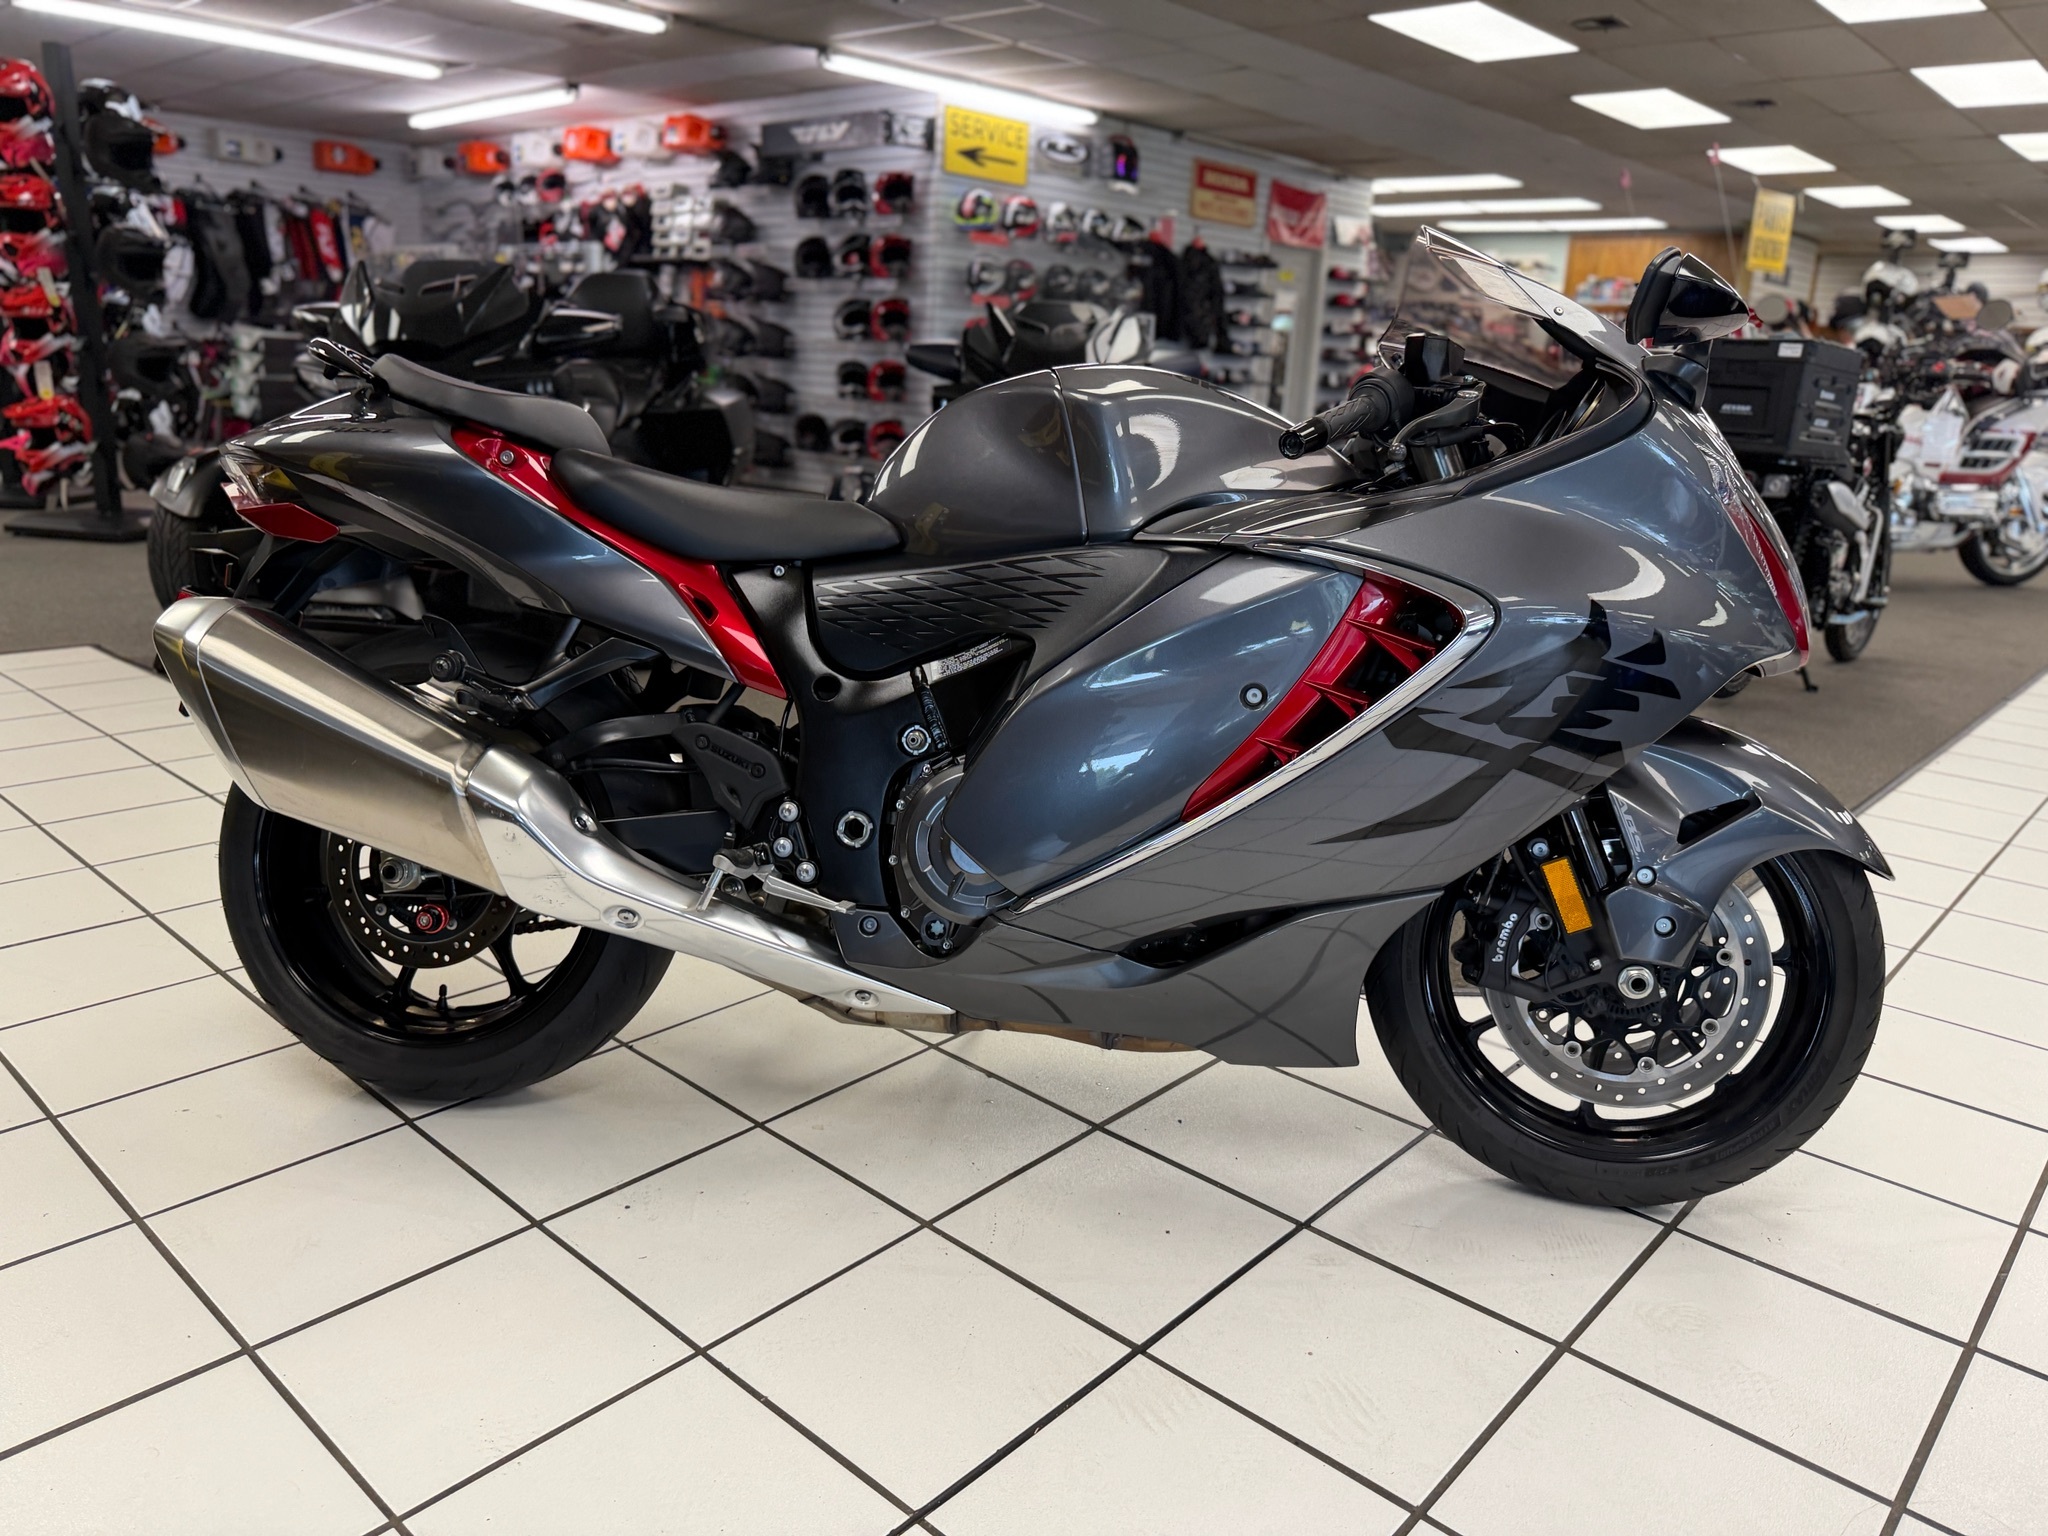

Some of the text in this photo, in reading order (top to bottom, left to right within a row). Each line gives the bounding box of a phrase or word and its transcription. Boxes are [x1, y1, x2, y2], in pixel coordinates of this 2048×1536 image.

[949, 111, 1026, 150] SERVICE
[710, 743, 750, 770] SUZUKI
[1613, 795, 1645, 856] ABS
[1491, 913, 1519, 963] brembo
